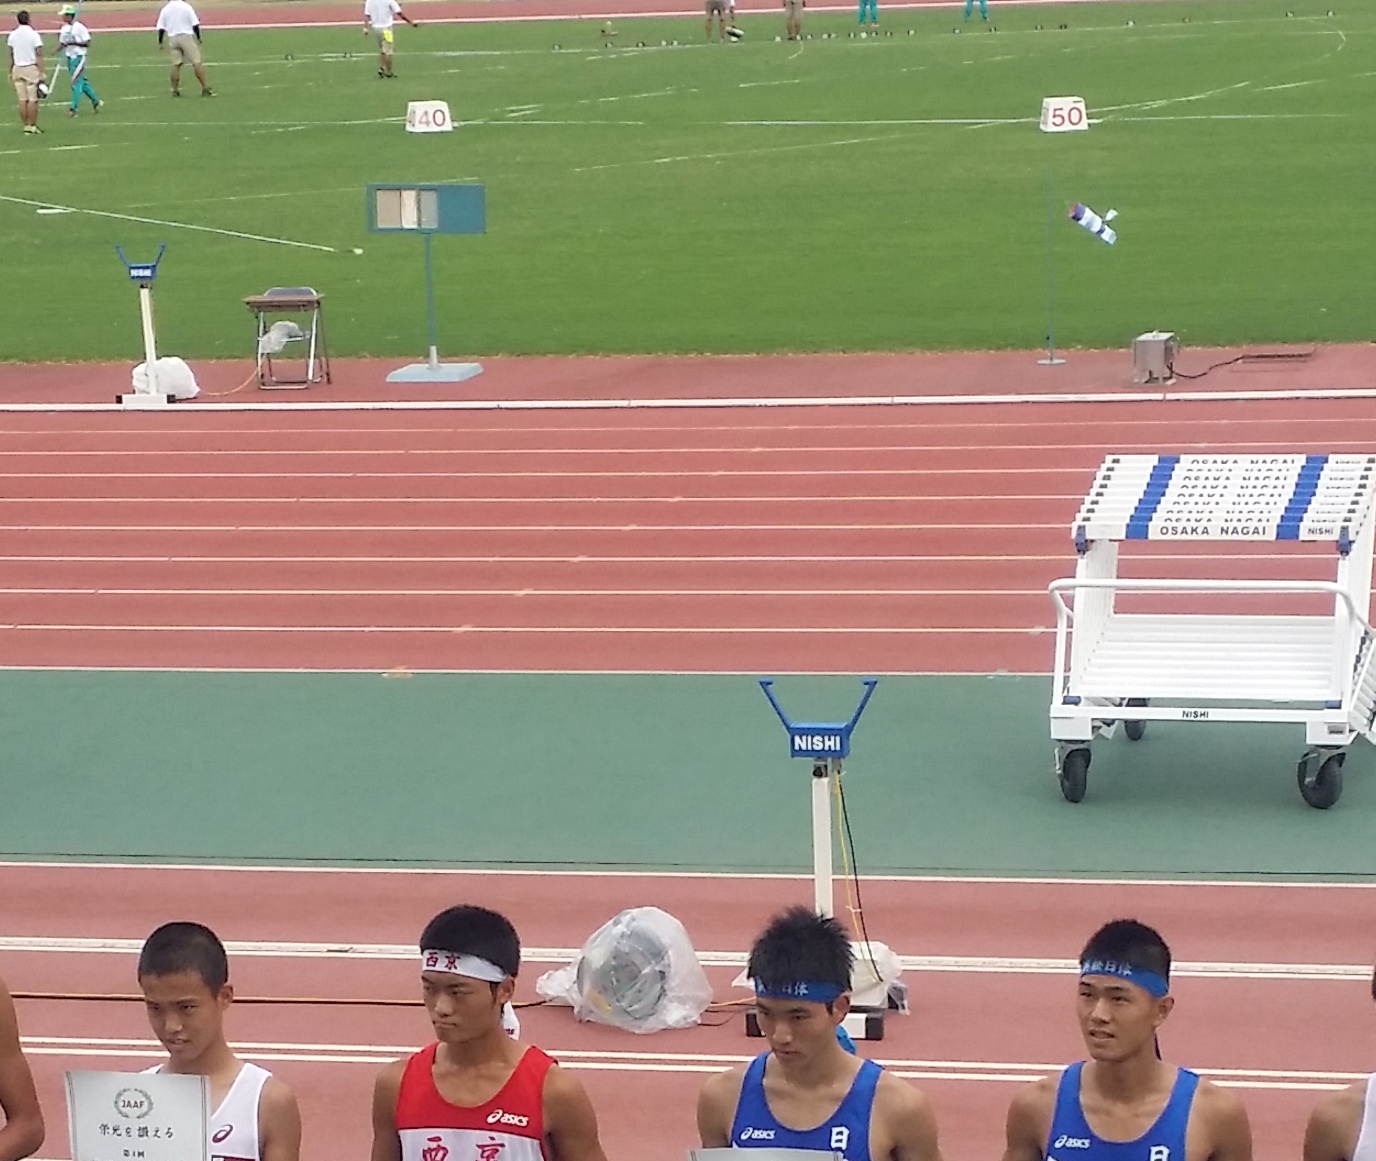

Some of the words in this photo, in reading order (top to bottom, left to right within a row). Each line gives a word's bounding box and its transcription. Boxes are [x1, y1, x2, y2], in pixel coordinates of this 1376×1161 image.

[418, 109, 445, 127] 40
[1052, 106, 1083, 127] 50
[1160, 526, 1210, 536] OSAKA
[1220, 526, 1266, 536] NAGAI
[1307, 527, 1334, 535] NISHI
[1182, 710, 1209, 718] NISHI
[793, 735, 841, 751] NISHI
[426, 951, 460, 971] 西京
[121, 1098, 146, 1109] JAAF
